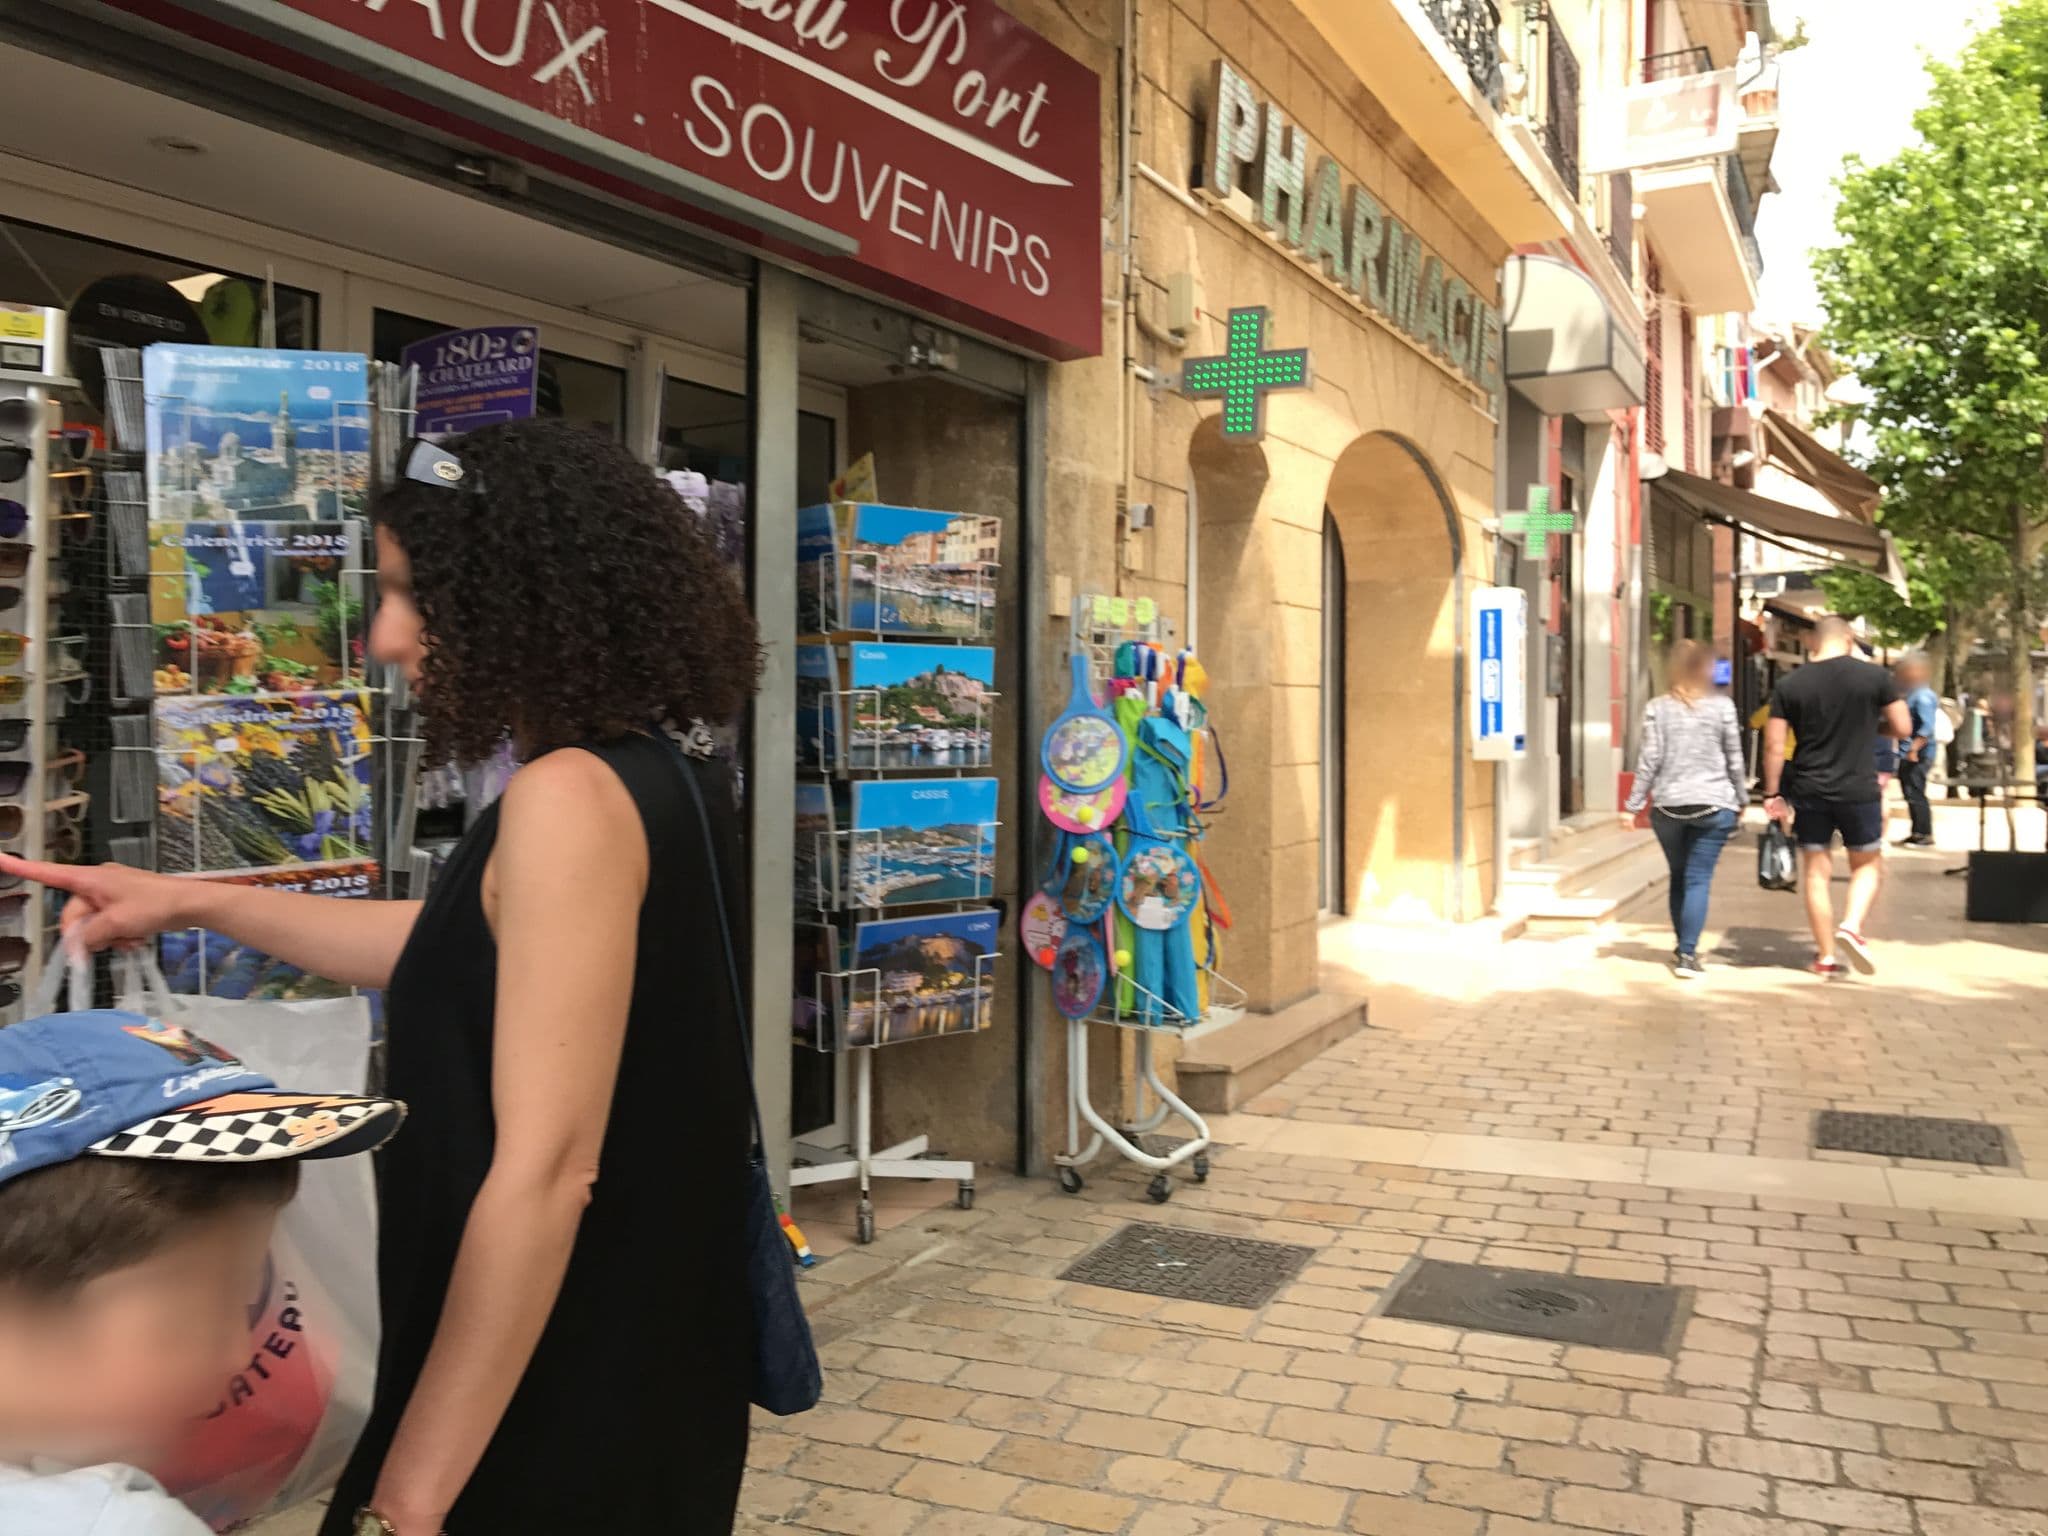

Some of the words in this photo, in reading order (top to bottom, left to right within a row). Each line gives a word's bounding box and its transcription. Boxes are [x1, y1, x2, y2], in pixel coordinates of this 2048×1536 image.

[873, 0, 1050, 149] Port
[683, 75, 1052, 297] SOUVENIRS
[1206, 58, 1498, 394] PHARMACIE
[302, 359, 361, 372] 2018
[292, 533, 351, 548] 2018
[301, 706, 356, 720] 2018
[311, 875, 369, 891] 2018
